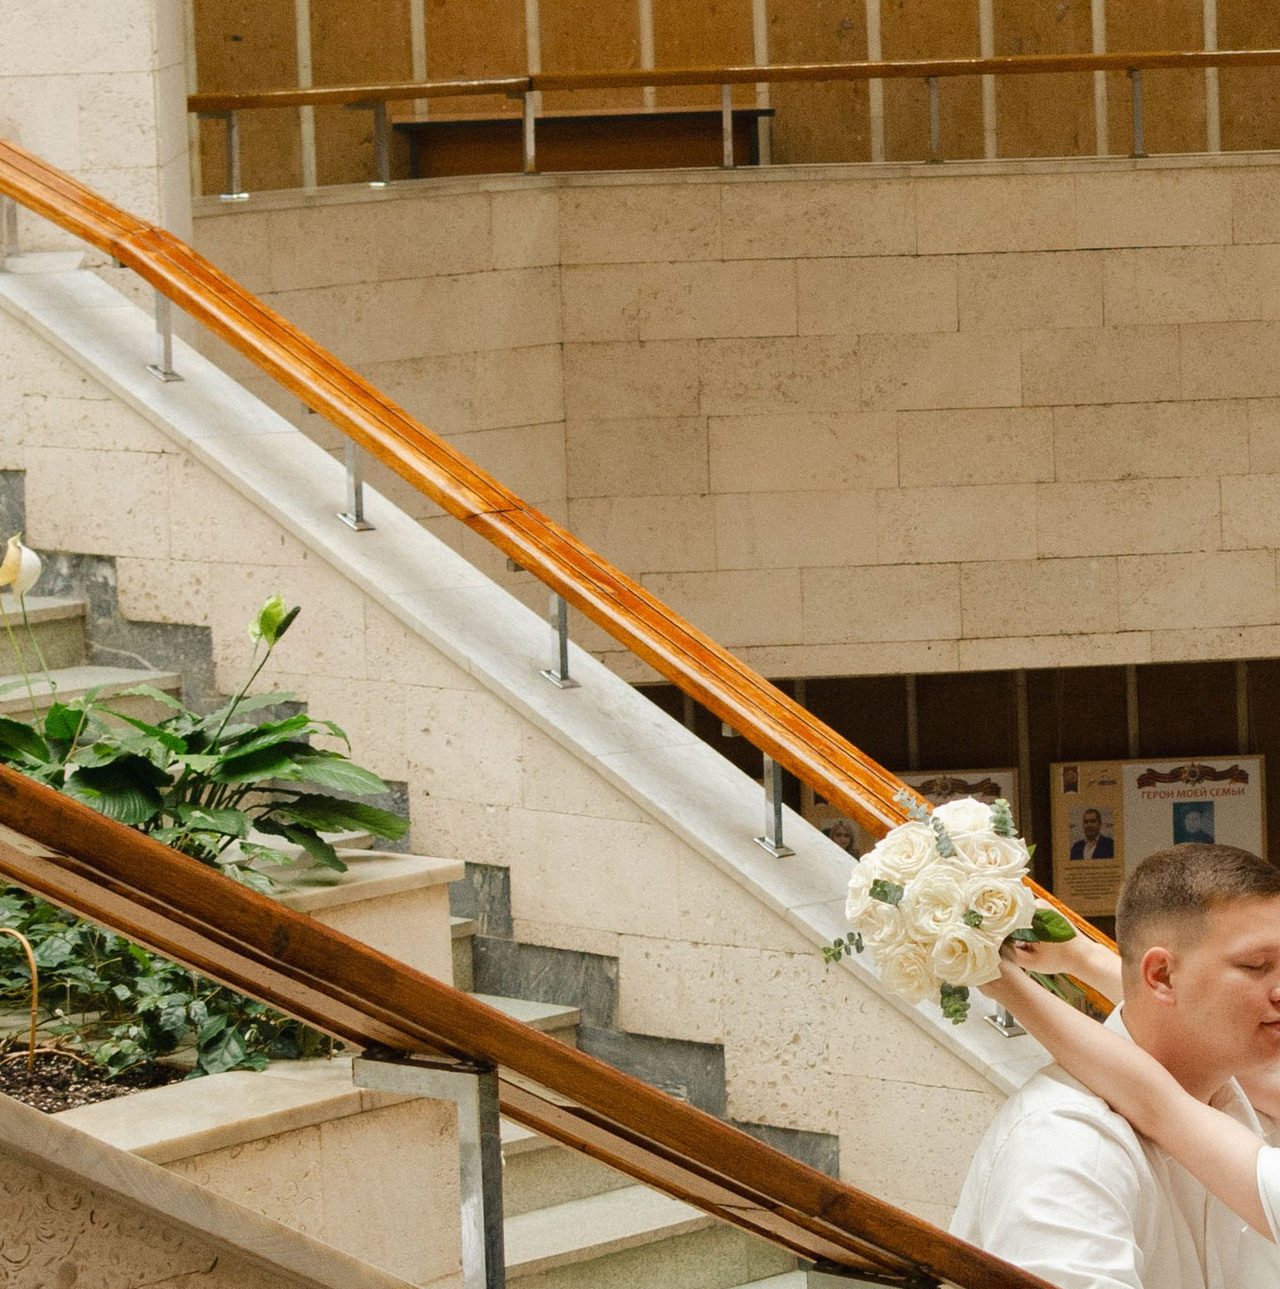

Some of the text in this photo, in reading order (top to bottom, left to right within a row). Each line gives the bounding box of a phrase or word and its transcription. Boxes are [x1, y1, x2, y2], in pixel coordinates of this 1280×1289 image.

[1142, 787, 1245, 799] ГЕРОИ МОЕЙ СЕМЬИ
